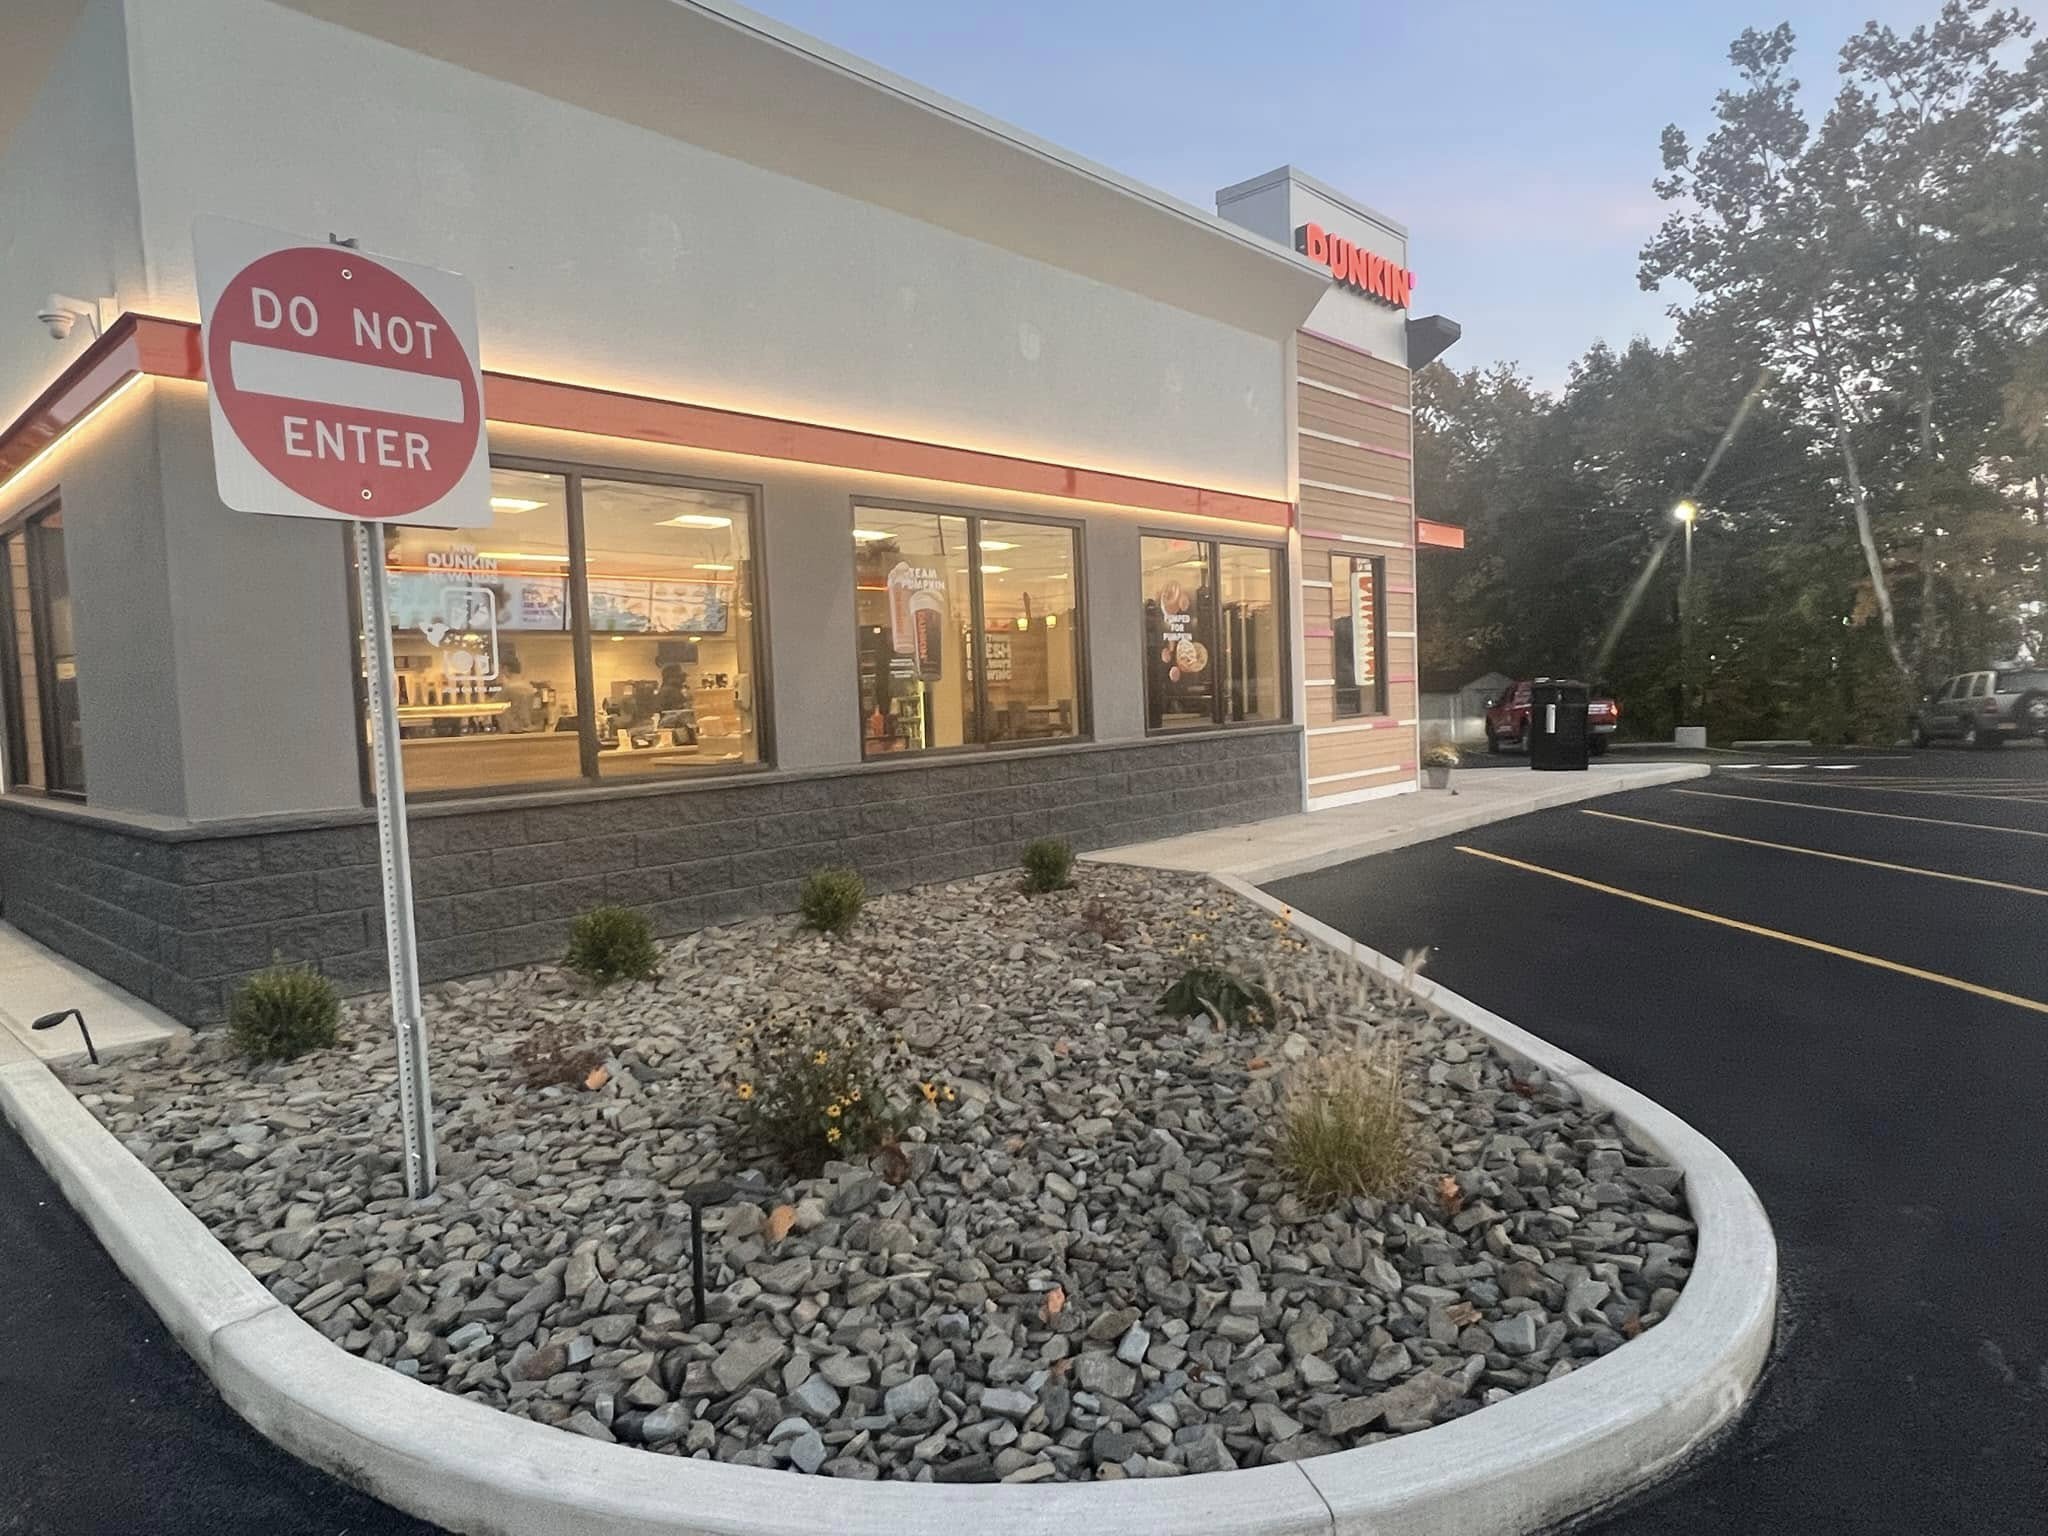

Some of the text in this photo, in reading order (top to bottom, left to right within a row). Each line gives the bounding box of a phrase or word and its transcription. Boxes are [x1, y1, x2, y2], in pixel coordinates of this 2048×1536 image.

[251, 287, 438, 359] DO NOT
[283, 415, 433, 471] ENTER
